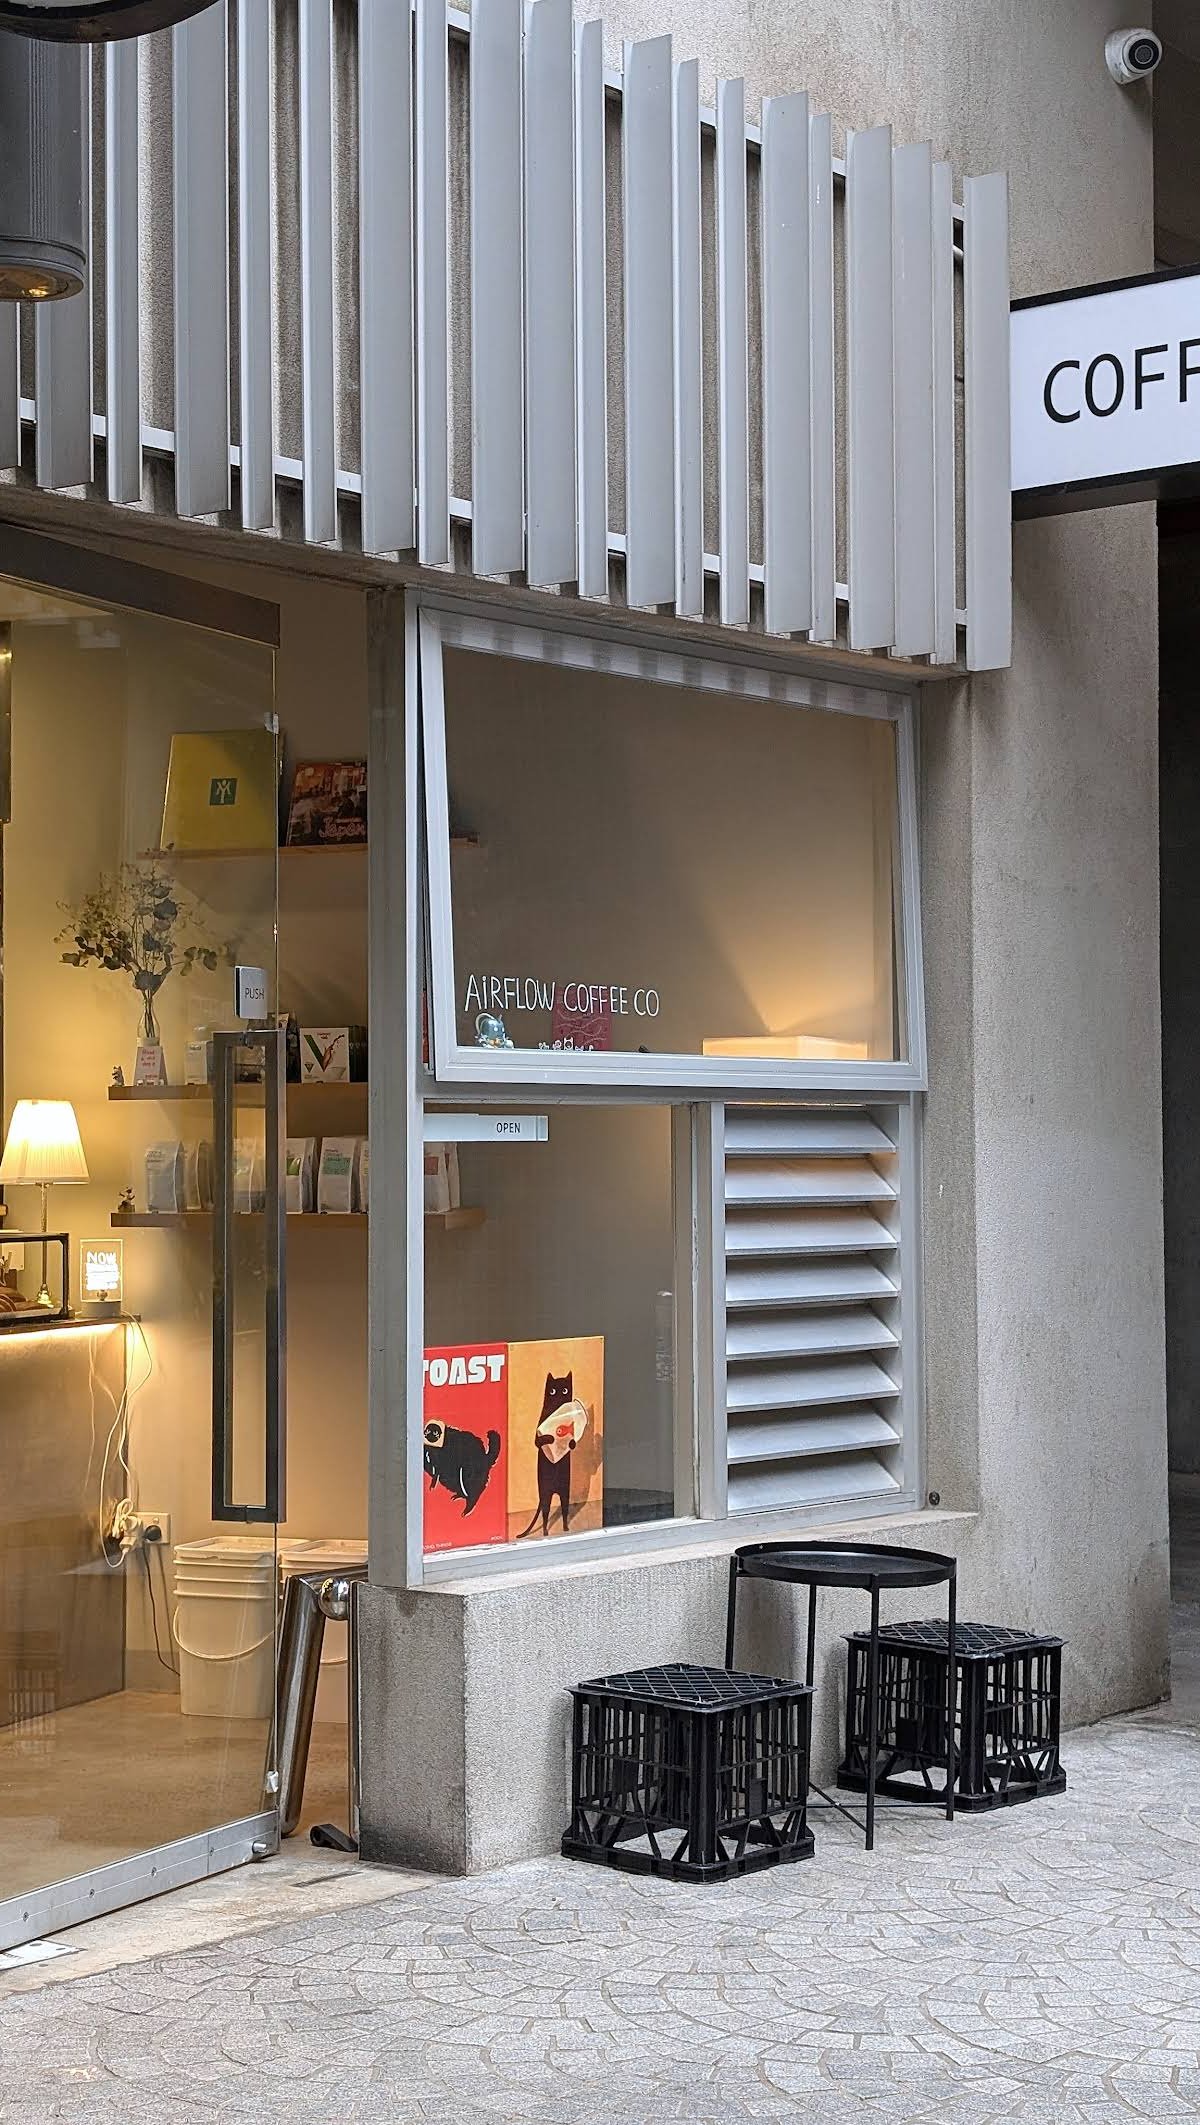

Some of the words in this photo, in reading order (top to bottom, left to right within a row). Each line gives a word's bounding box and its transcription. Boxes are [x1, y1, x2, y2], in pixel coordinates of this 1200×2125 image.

[1043, 337, 1200, 424] COFF
[244, 986, 265, 1000] PUSH
[563, 981, 629, 1015] COFFEE
[633, 987, 660, 1017] CO
[495, 1121, 521, 1135] OPEN
[86, 1251, 117, 1266] NOW
